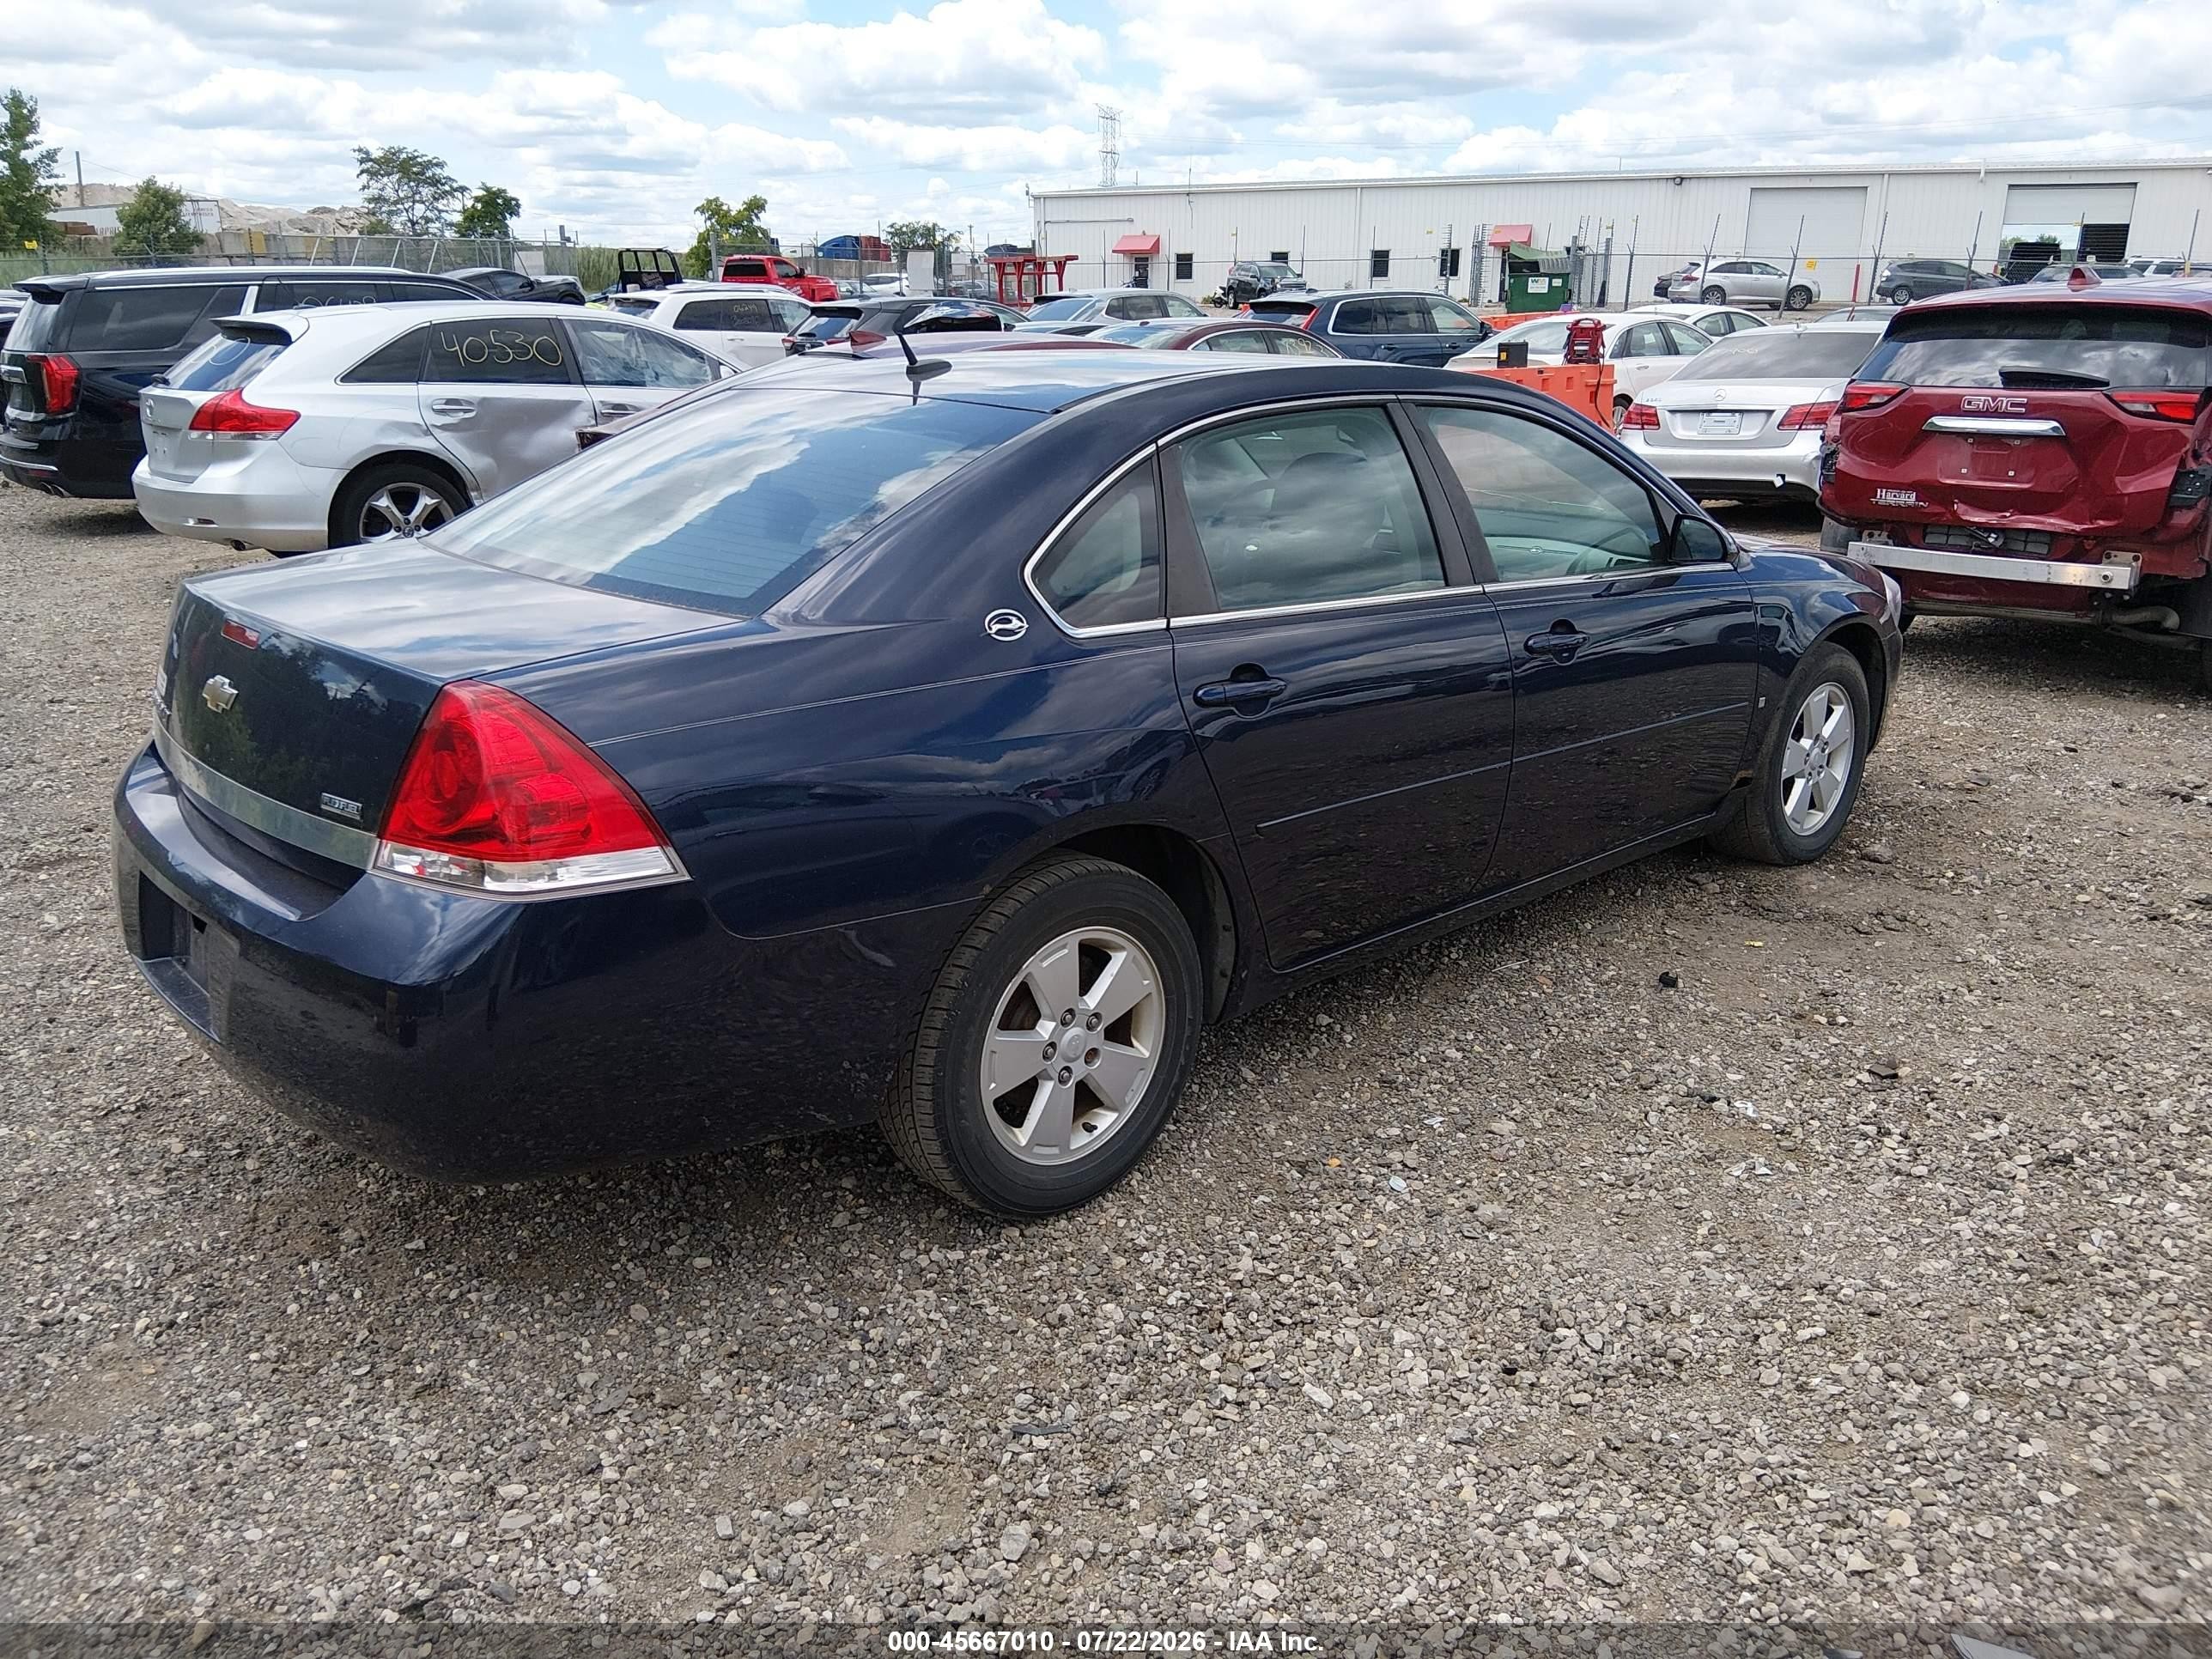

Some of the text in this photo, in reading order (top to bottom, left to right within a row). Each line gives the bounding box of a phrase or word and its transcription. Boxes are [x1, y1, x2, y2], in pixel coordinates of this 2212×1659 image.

[441, 329, 562, 367] 40530
[1960, 396, 2027, 413] GMC
[1875, 488, 1917, 500] Harvard
